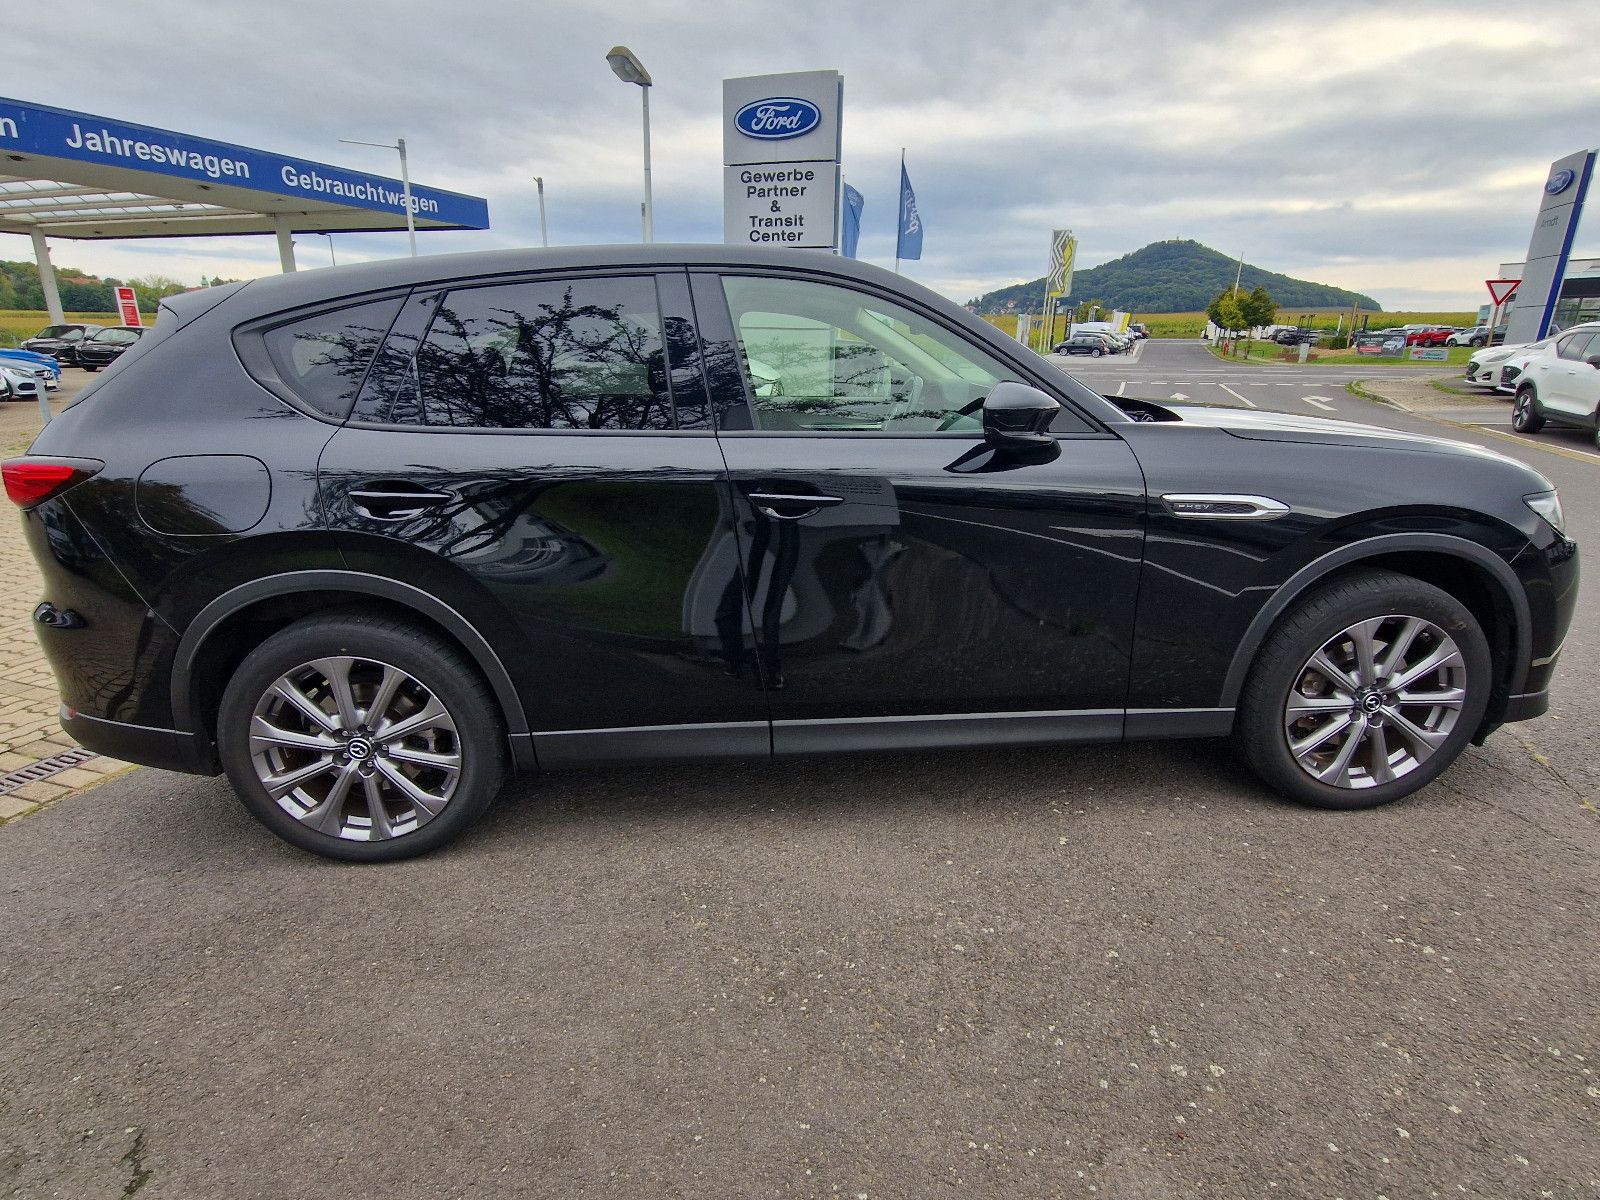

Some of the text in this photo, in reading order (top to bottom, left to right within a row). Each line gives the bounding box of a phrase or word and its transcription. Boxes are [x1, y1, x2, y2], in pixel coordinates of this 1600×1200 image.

[751, 105, 803, 131] Ford
[65, 123, 250, 179] Jahreswagen
[281, 165, 439, 214] Gebrauchtwagen
[741, 168, 815, 184] Gewerbe
[747, 185, 807, 199] Partner
[770, 200, 782, 212] &
[749, 214, 804, 228] Transit
[749, 230, 804, 242] Center
